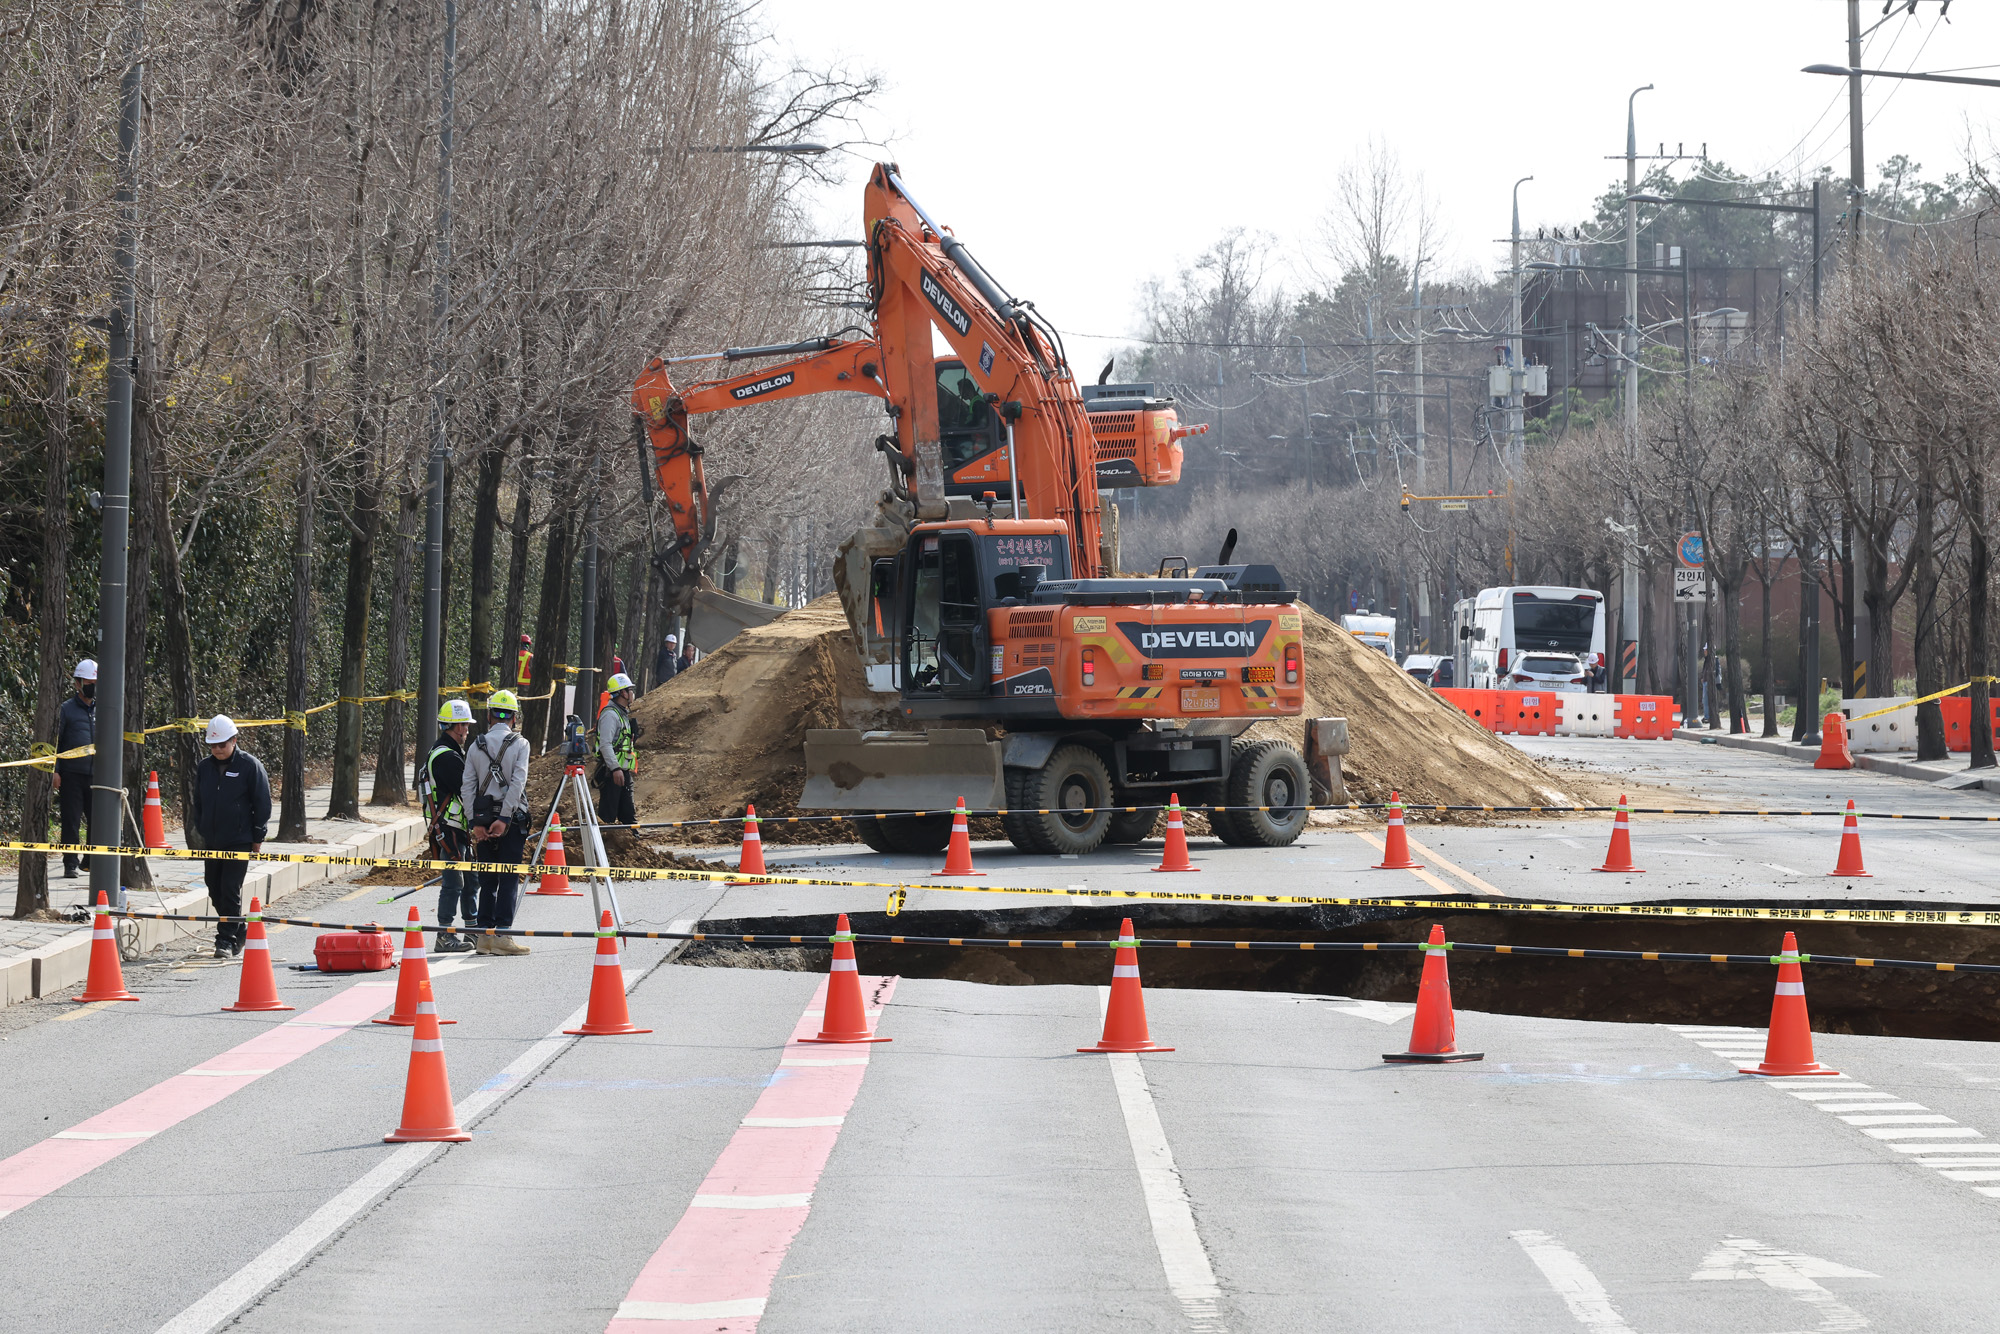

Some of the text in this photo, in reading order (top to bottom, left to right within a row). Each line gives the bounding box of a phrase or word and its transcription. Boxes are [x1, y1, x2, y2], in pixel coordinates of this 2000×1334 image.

[923, 276, 968, 333] DEVELON
[736, 375, 792, 398] DEVELON
[1677, 571, 1714, 582] 견인지
[1141, 631, 1255, 649] DEVELON
[329, 856, 351, 865] FIRE
[354, 857, 377, 866] LINE
[471, 862, 493, 872] FIRE
[495, 863, 518, 873] LINE
[1711, 908, 1734, 917] FIRE
[1737, 909, 1759, 917] LINE
[1849, 910, 1947, 922] FIRE LINE 출입통제
[1984, 912, 2000, 924] FIR
